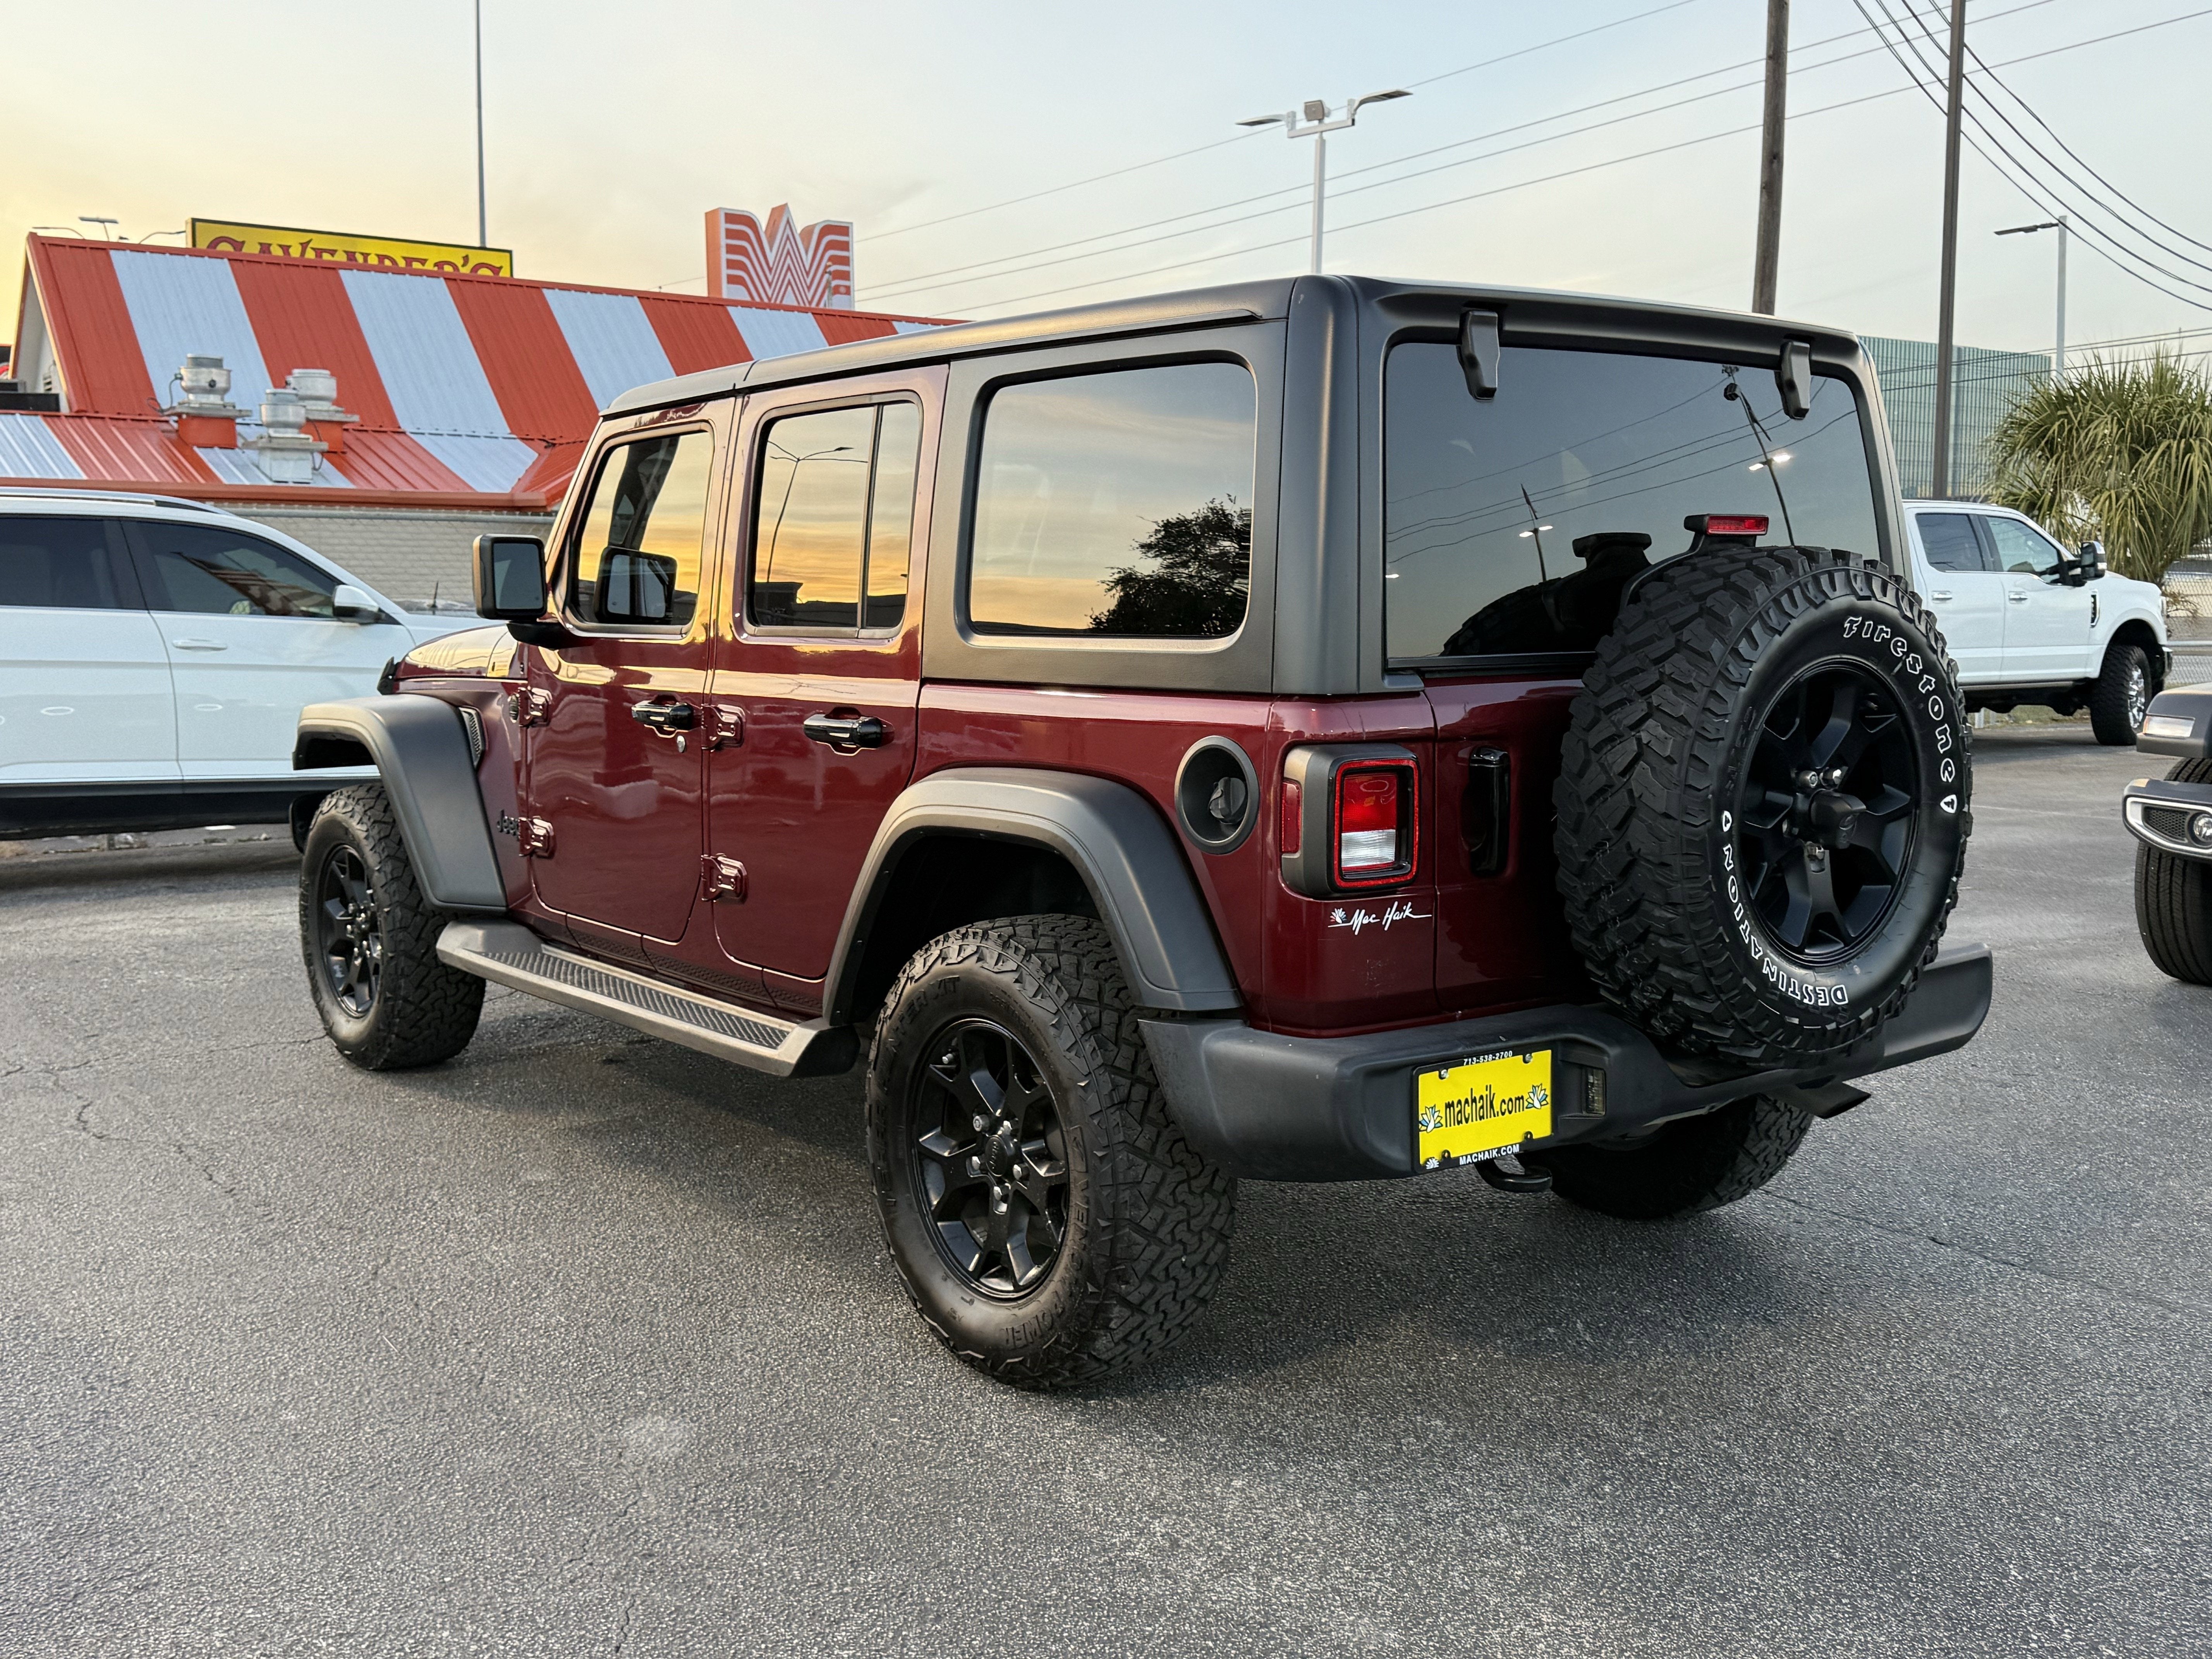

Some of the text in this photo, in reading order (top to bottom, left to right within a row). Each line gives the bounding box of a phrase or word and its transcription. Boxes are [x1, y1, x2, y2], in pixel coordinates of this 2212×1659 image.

[1843, 616, 1955, 782] Firestone
[1382, 901, 1432, 931] Haik
[1723, 843, 1848, 1006] DESTINATION
[1463, 1050, 1513, 1066] 713-538-2700
[1444, 1084, 1525, 1128] machaik.com
[1459, 1144, 1520, 1166] MACHAIK.COM
